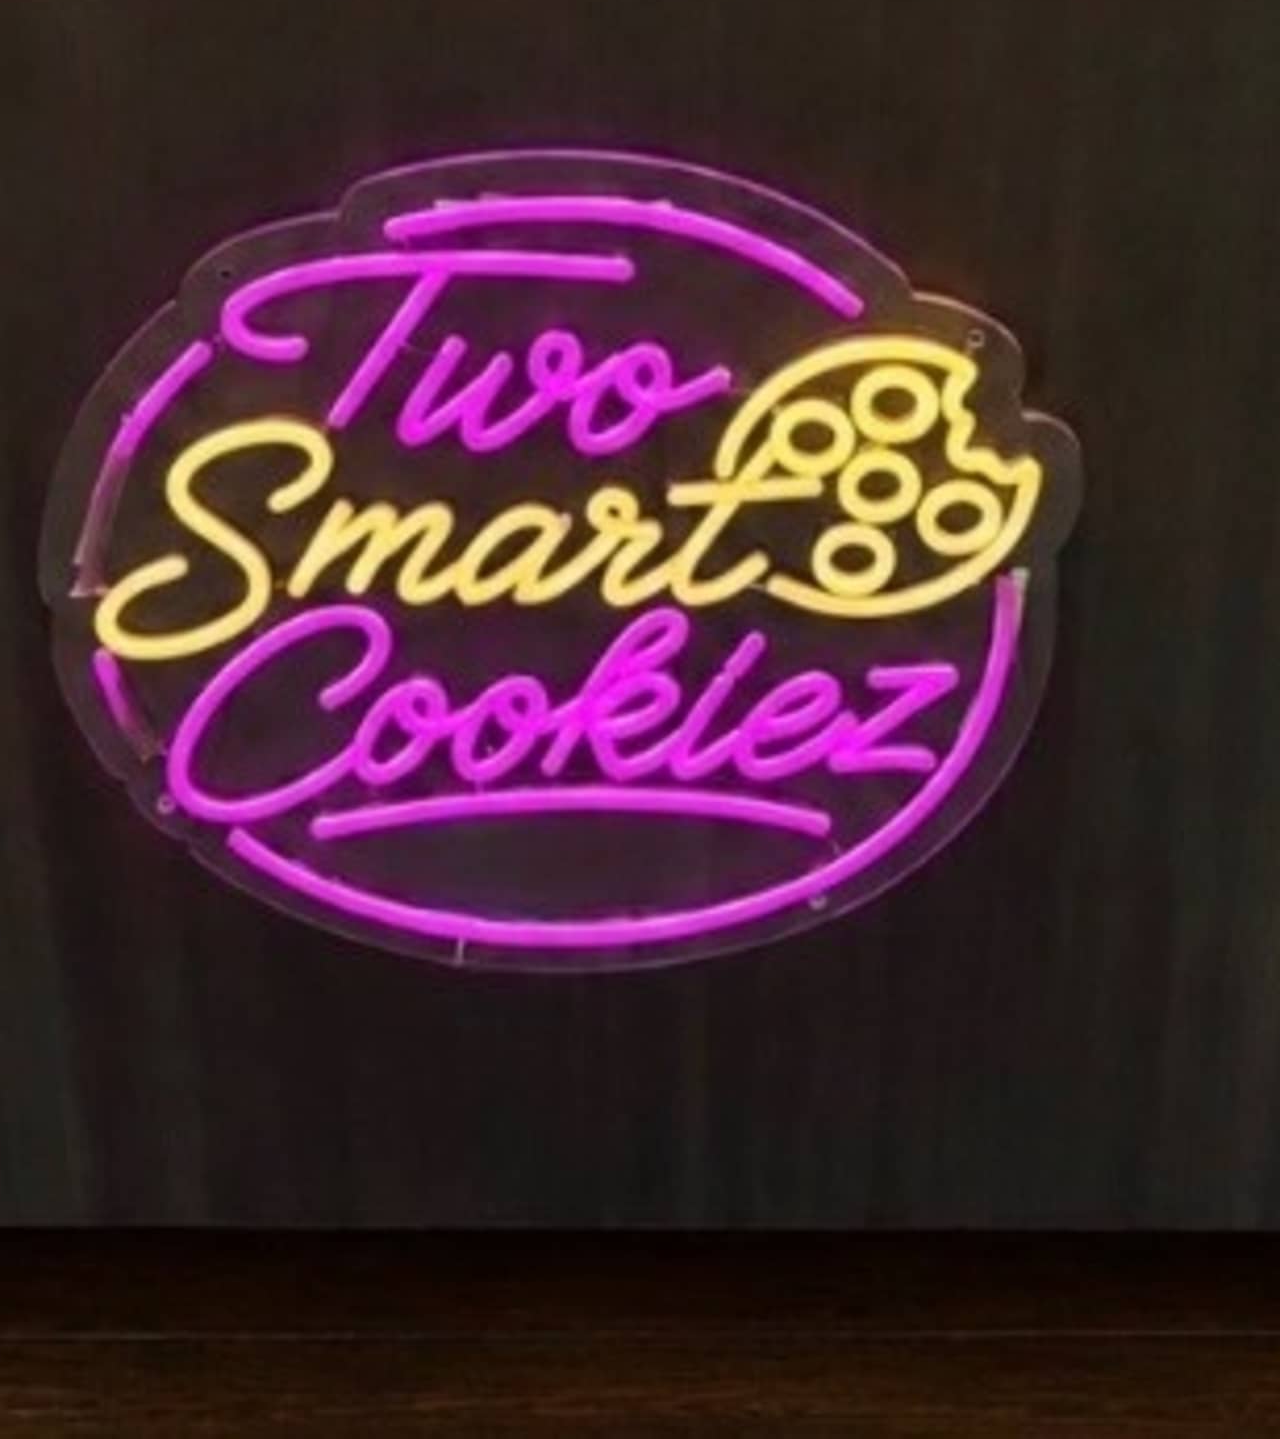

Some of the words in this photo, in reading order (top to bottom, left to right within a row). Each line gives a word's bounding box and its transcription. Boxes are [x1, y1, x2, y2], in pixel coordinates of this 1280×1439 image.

[219, 248, 732, 455] Two
[94, 418, 823, 660] Smart
[166, 604, 959, 823] Cookiez
